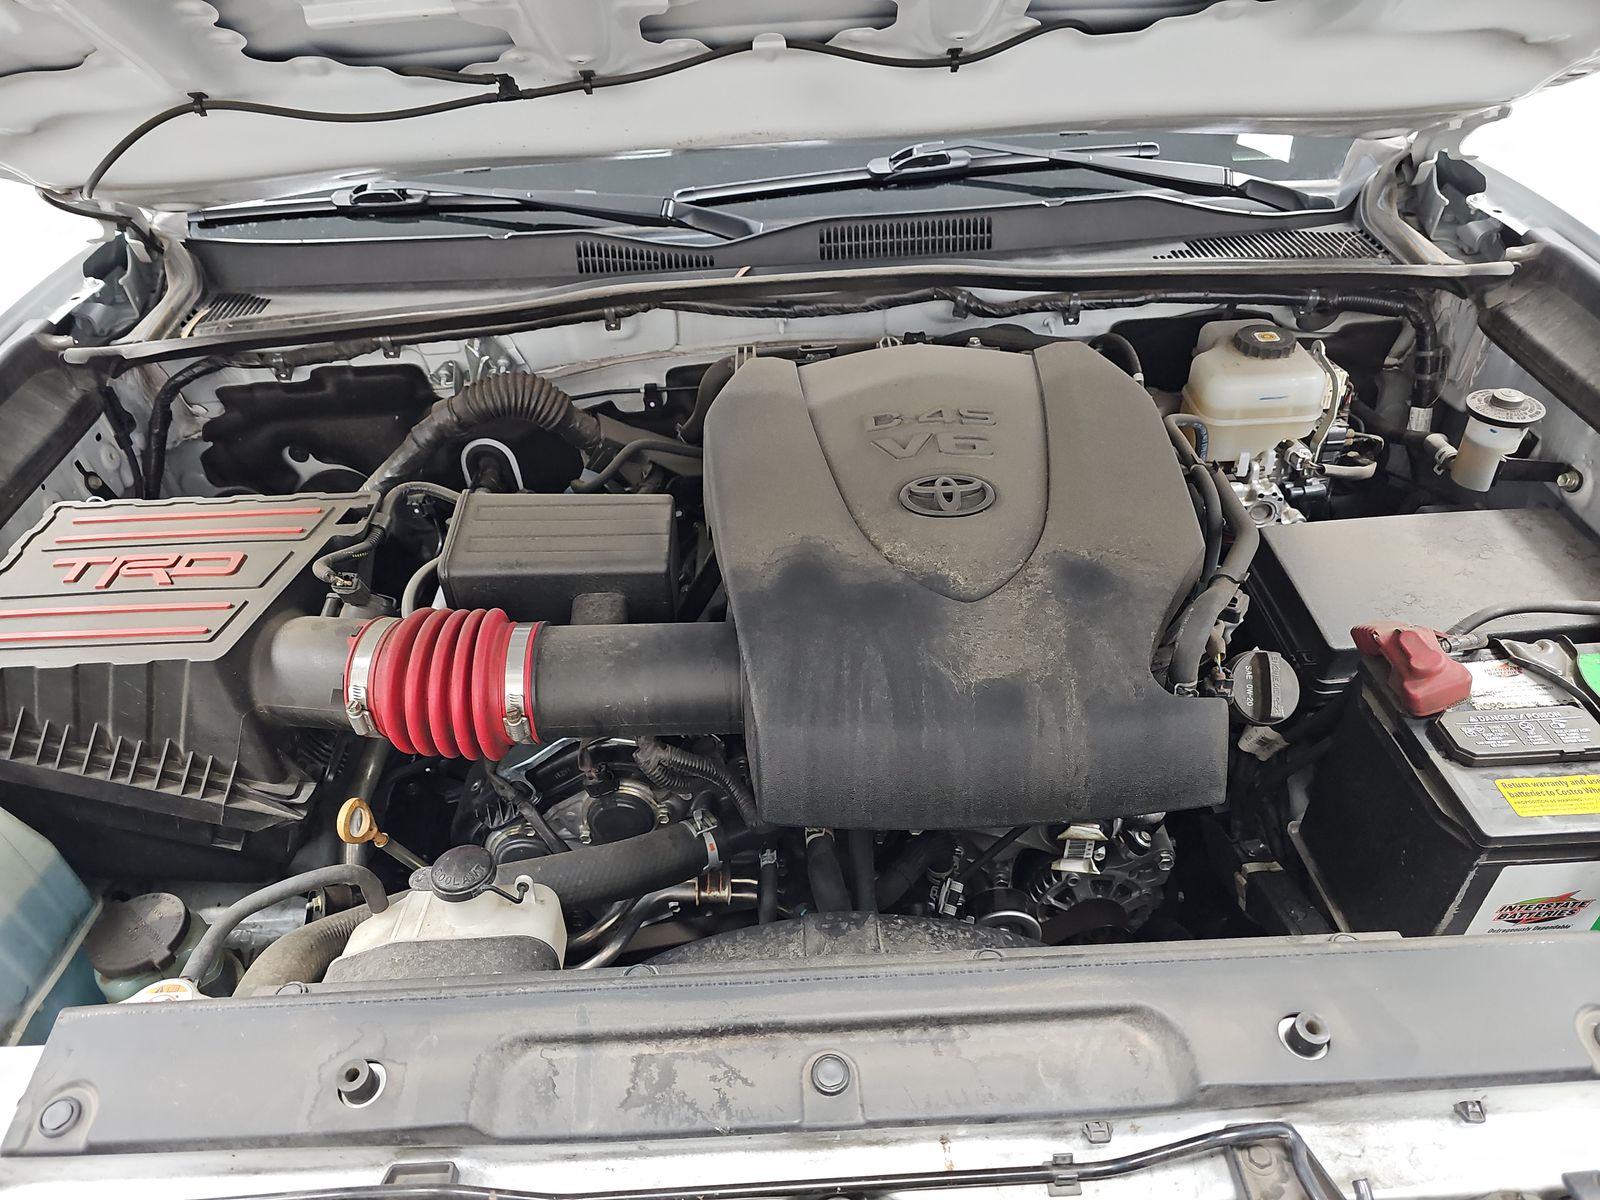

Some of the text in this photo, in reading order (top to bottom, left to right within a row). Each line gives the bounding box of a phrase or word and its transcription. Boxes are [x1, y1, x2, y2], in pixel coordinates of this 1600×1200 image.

[870, 432, 995, 460] V6
[52, 551, 248, 590] TRD
[1245, 665, 1254, 707] SAE 0W-20
[1477, 714, 1517, 722] DANGER
[1526, 711, 1562, 719] POISON
[1502, 781, 1531, 789] Return
[1532, 779, 1568, 788] warranty
[1569, 777, 1585, 786] and
[1507, 789, 1546, 798] batteries
[1556, 788, 1584, 796] Costco
[434, 863, 486, 886] COOLANT
[1500, 900, 1587, 912] INTERSTATE
[1498, 908, 1578, 920] BATTERIES
[1488, 925, 1532, 934] Outrageously
